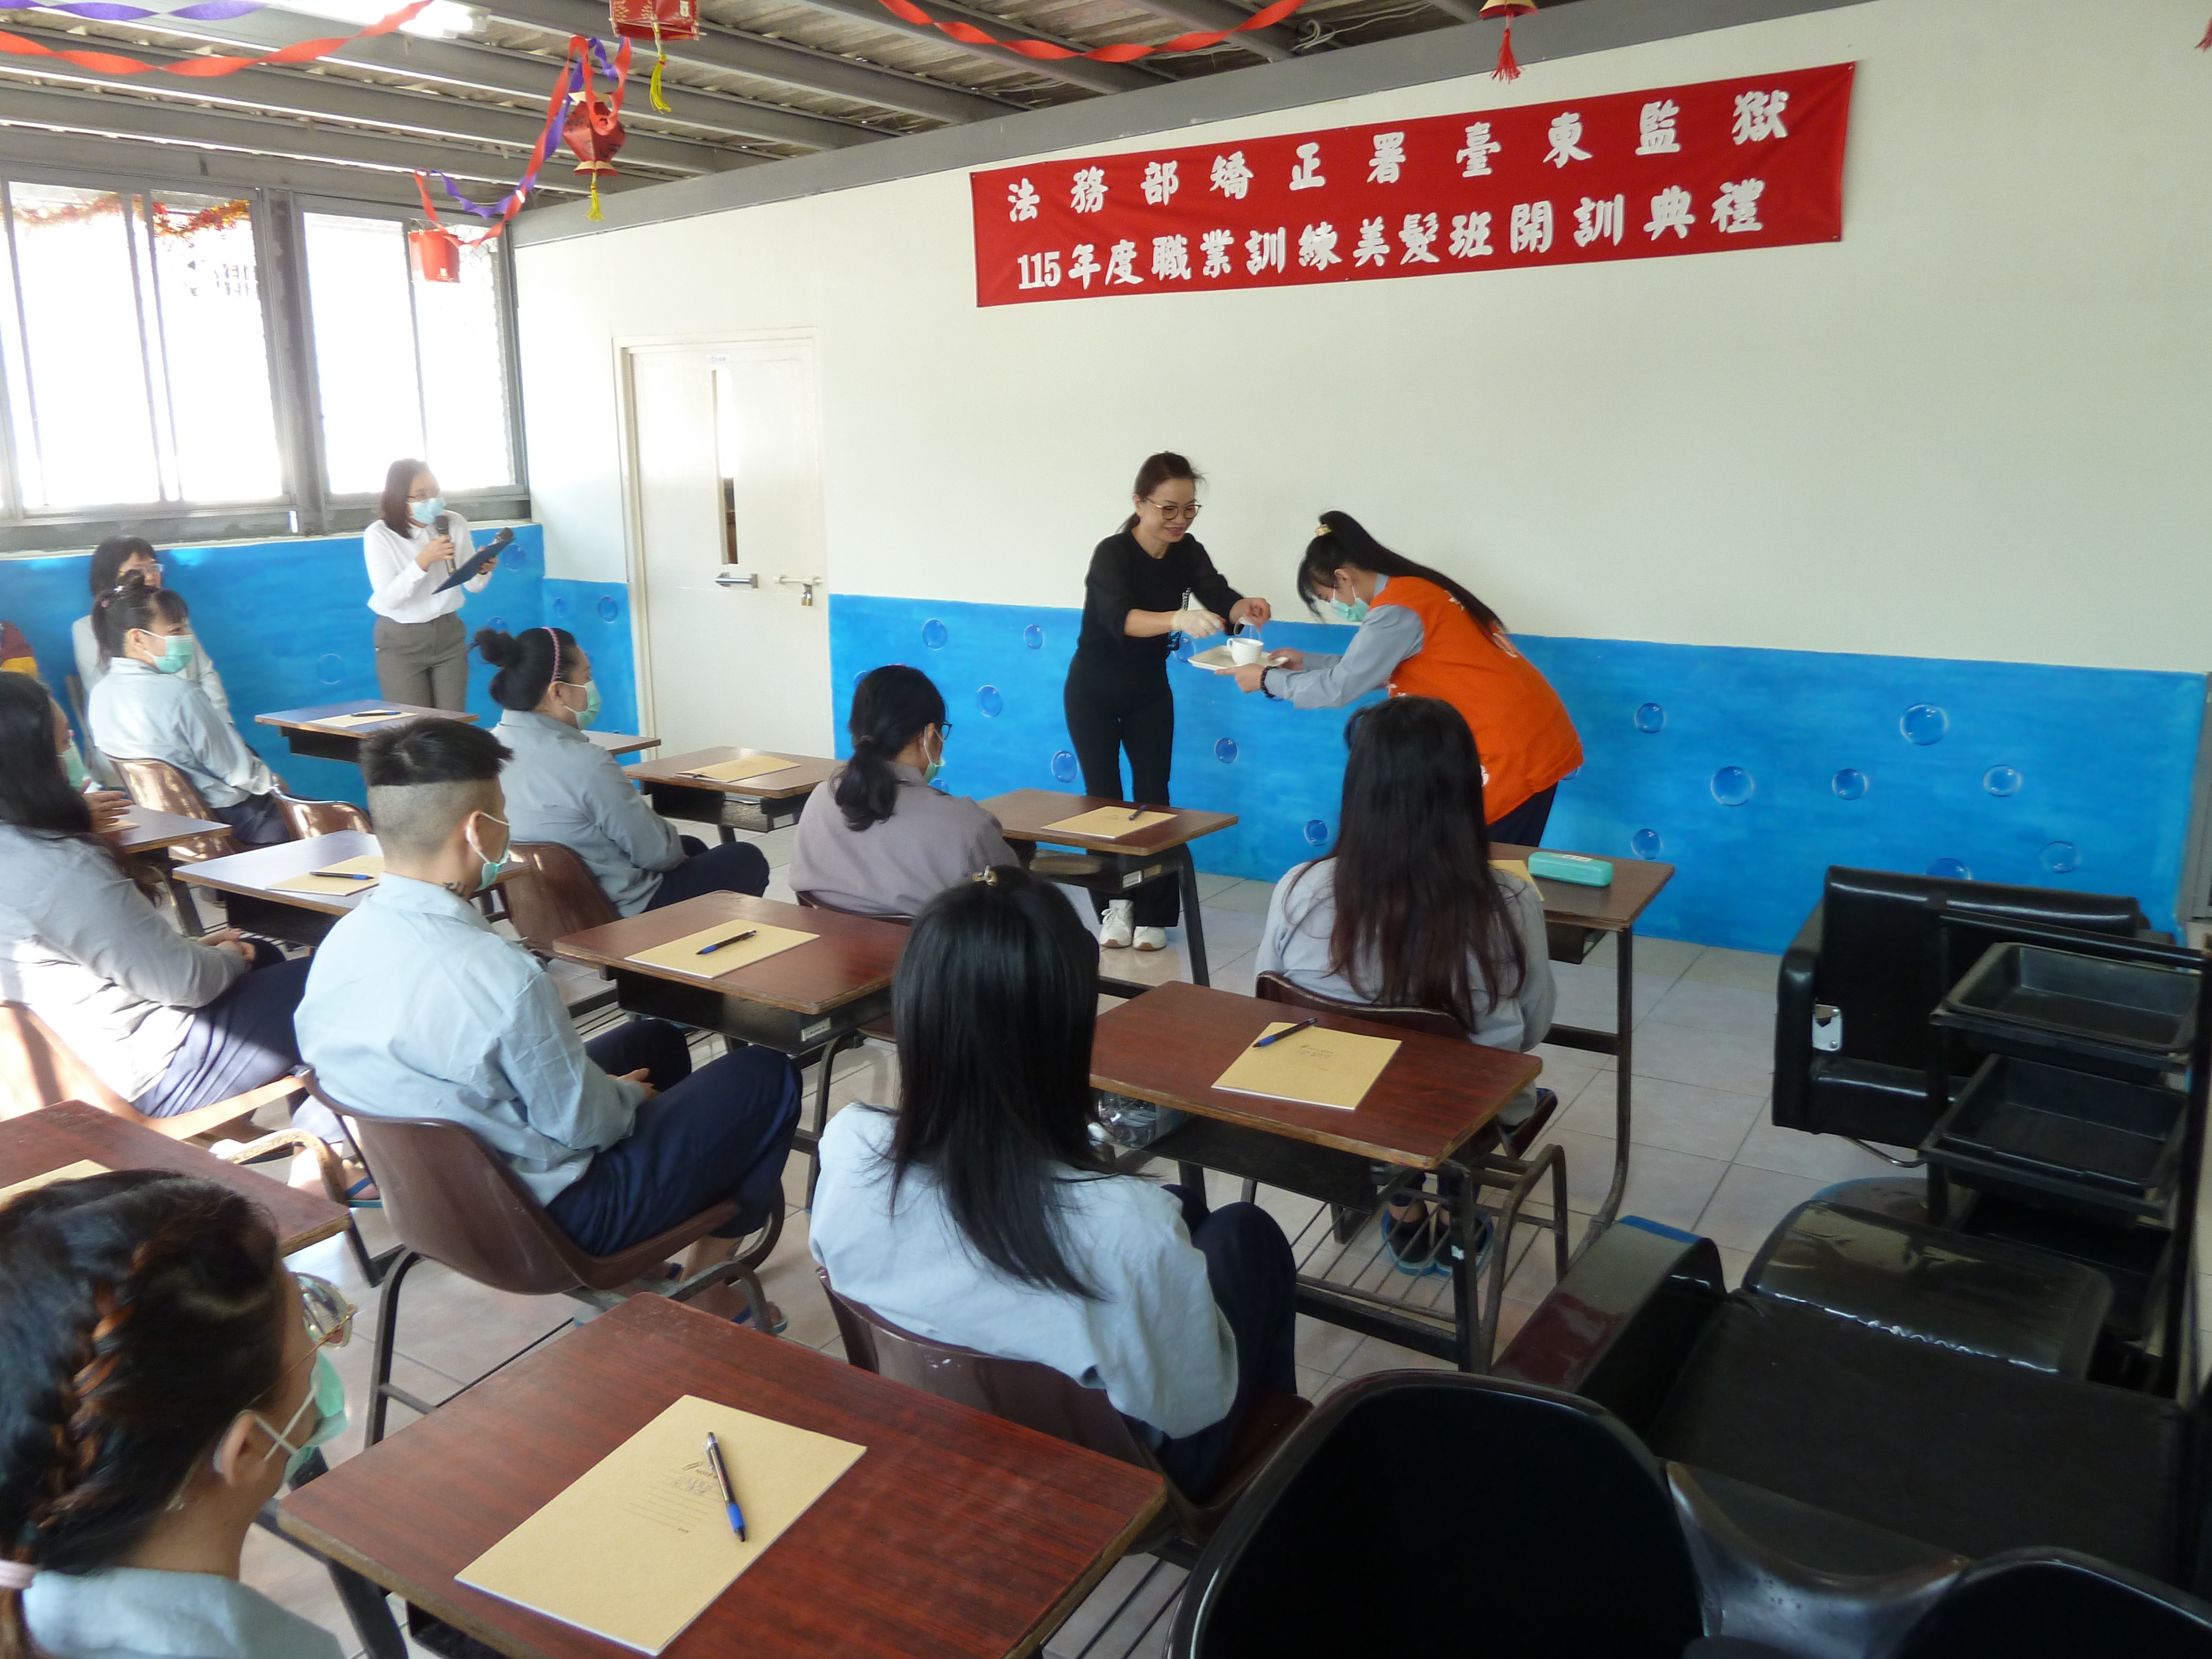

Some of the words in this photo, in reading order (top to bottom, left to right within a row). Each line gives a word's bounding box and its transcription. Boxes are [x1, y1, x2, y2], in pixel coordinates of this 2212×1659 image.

[1007, 89, 1790, 222] 法務部矯正署臺東監獄
[1017, 178, 1766, 290] 115年度職業訓練美髮班開訓典禮
